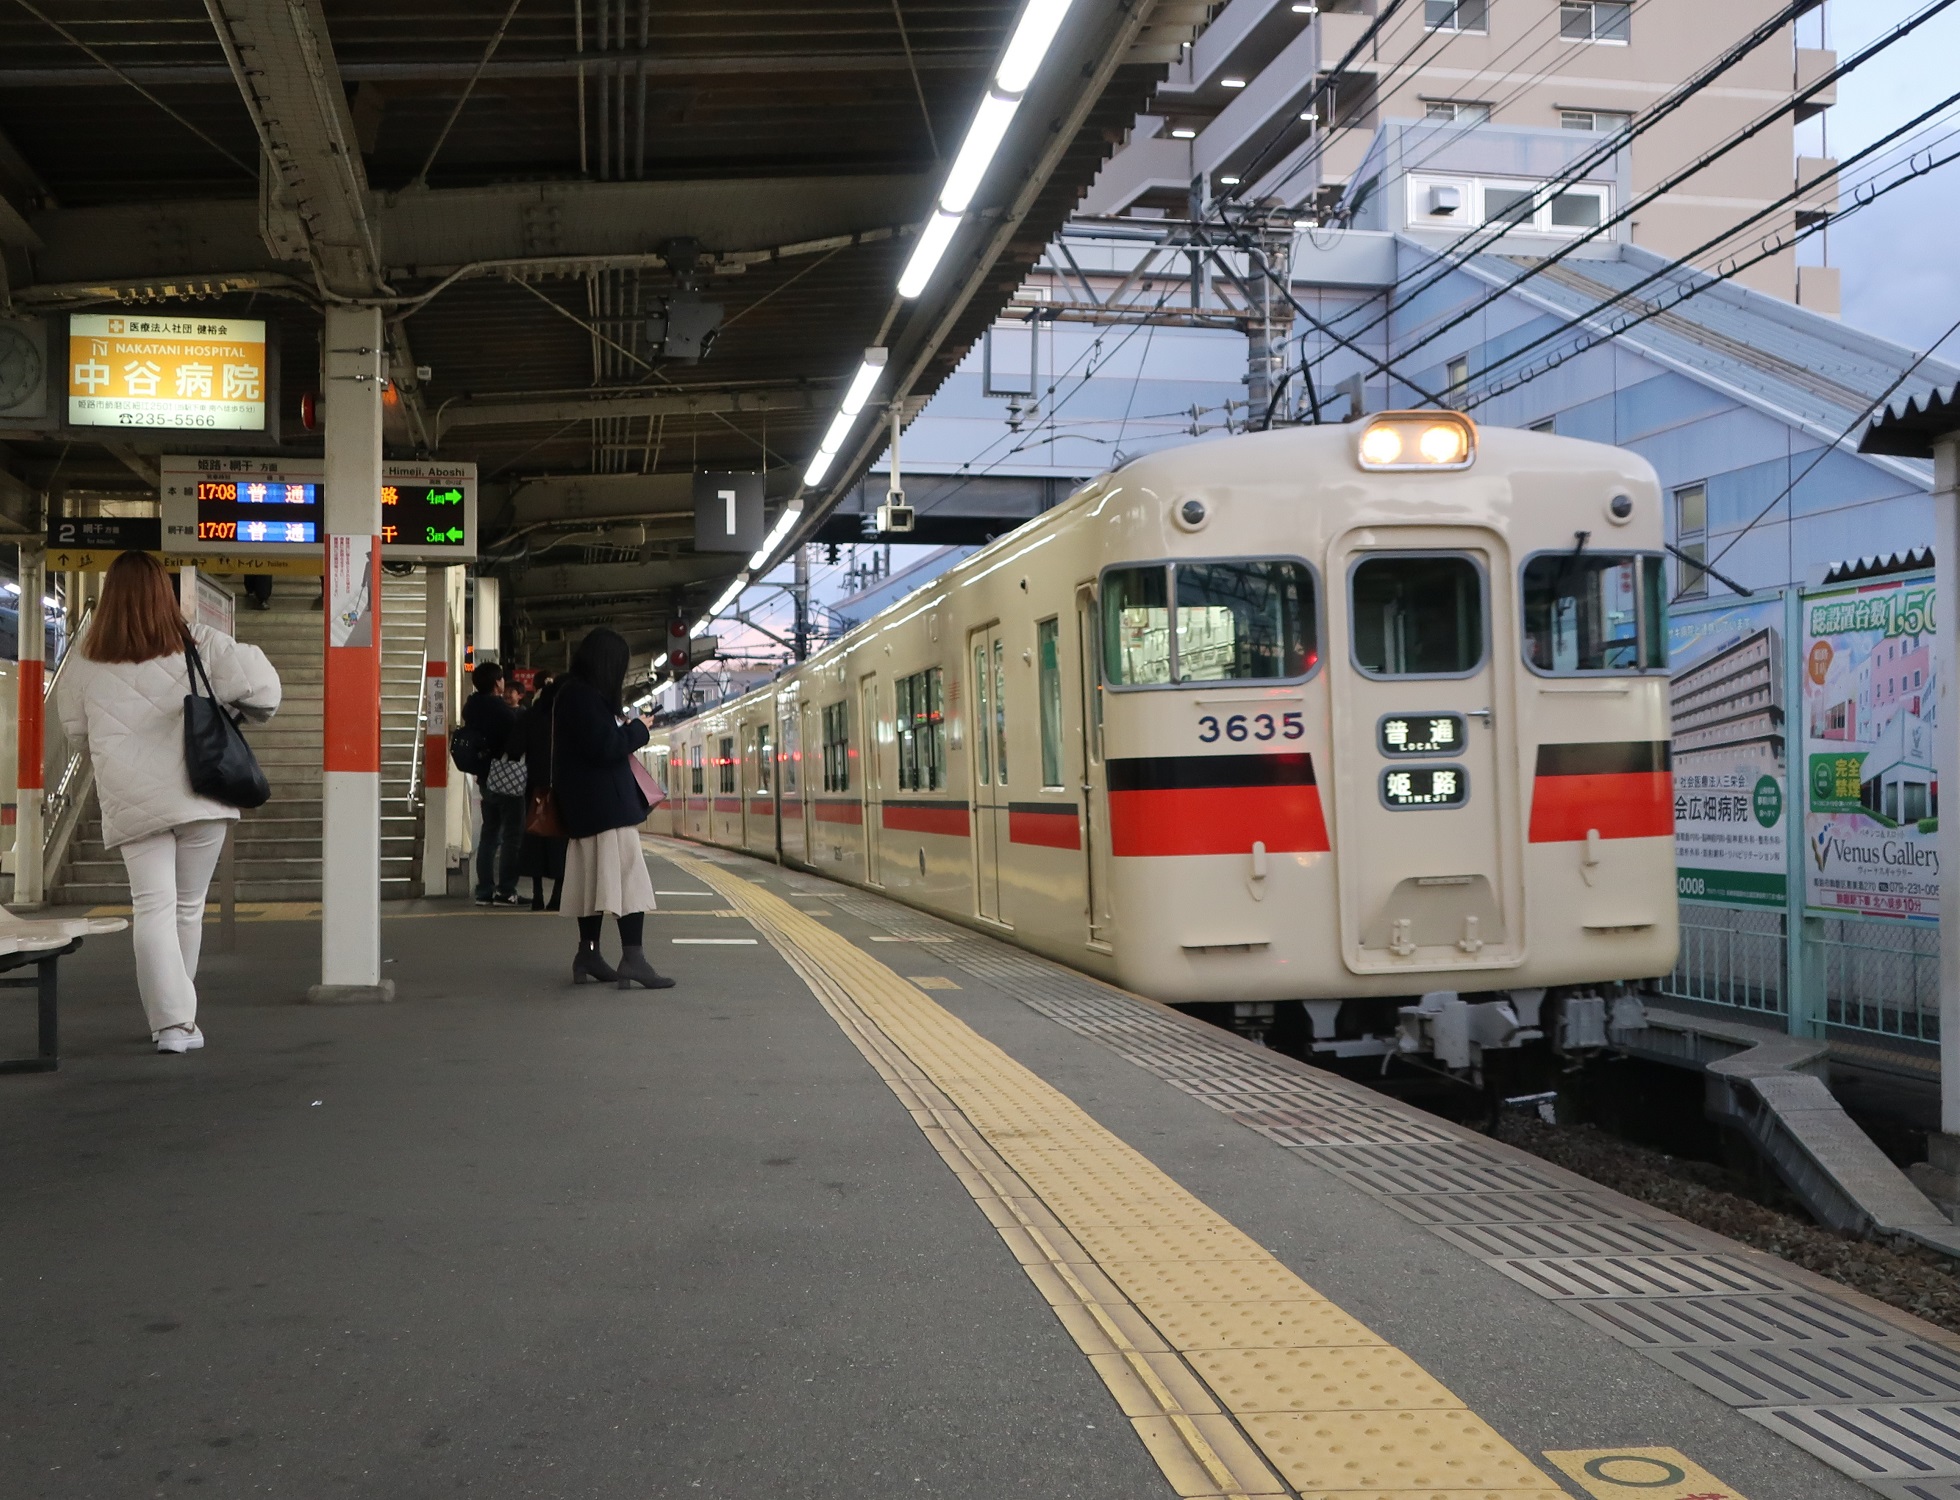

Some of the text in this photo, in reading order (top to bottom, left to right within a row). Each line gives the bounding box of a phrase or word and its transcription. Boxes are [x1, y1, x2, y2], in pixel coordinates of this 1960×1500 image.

[129, 321, 228, 335] 医療法人社団 健裕会
[115, 343, 246, 358] NAKATANI HOSPITAL
[74, 358, 260, 400] 中谷病院
[135, 413, 216, 427] 235-5566
[389, 467, 425, 477] Himeji,
[428, 467, 465, 477] Aboshi
[198, 483, 305, 503] 17:08 普通
[717, 489, 736, 535] 1
[58, 523, 76, 543] 2
[198, 521, 305, 542] 17:07 普通
[164, 557, 184, 567] Exit
[237, 559, 264, 569] トイレ
[1198, 711, 1305, 743] 3635
[1384, 719, 1454, 745] 普通
[1400, 743, 1441, 752] LOCAL
[1835, 758, 1861, 778] 完全
[1386, 770, 1456, 797] 姫路
[1835, 779, 1862, 798] 禁煙
[1398, 794, 1447, 804] HIMEJI
[1832, 838, 1940, 876] Venus Gallery
